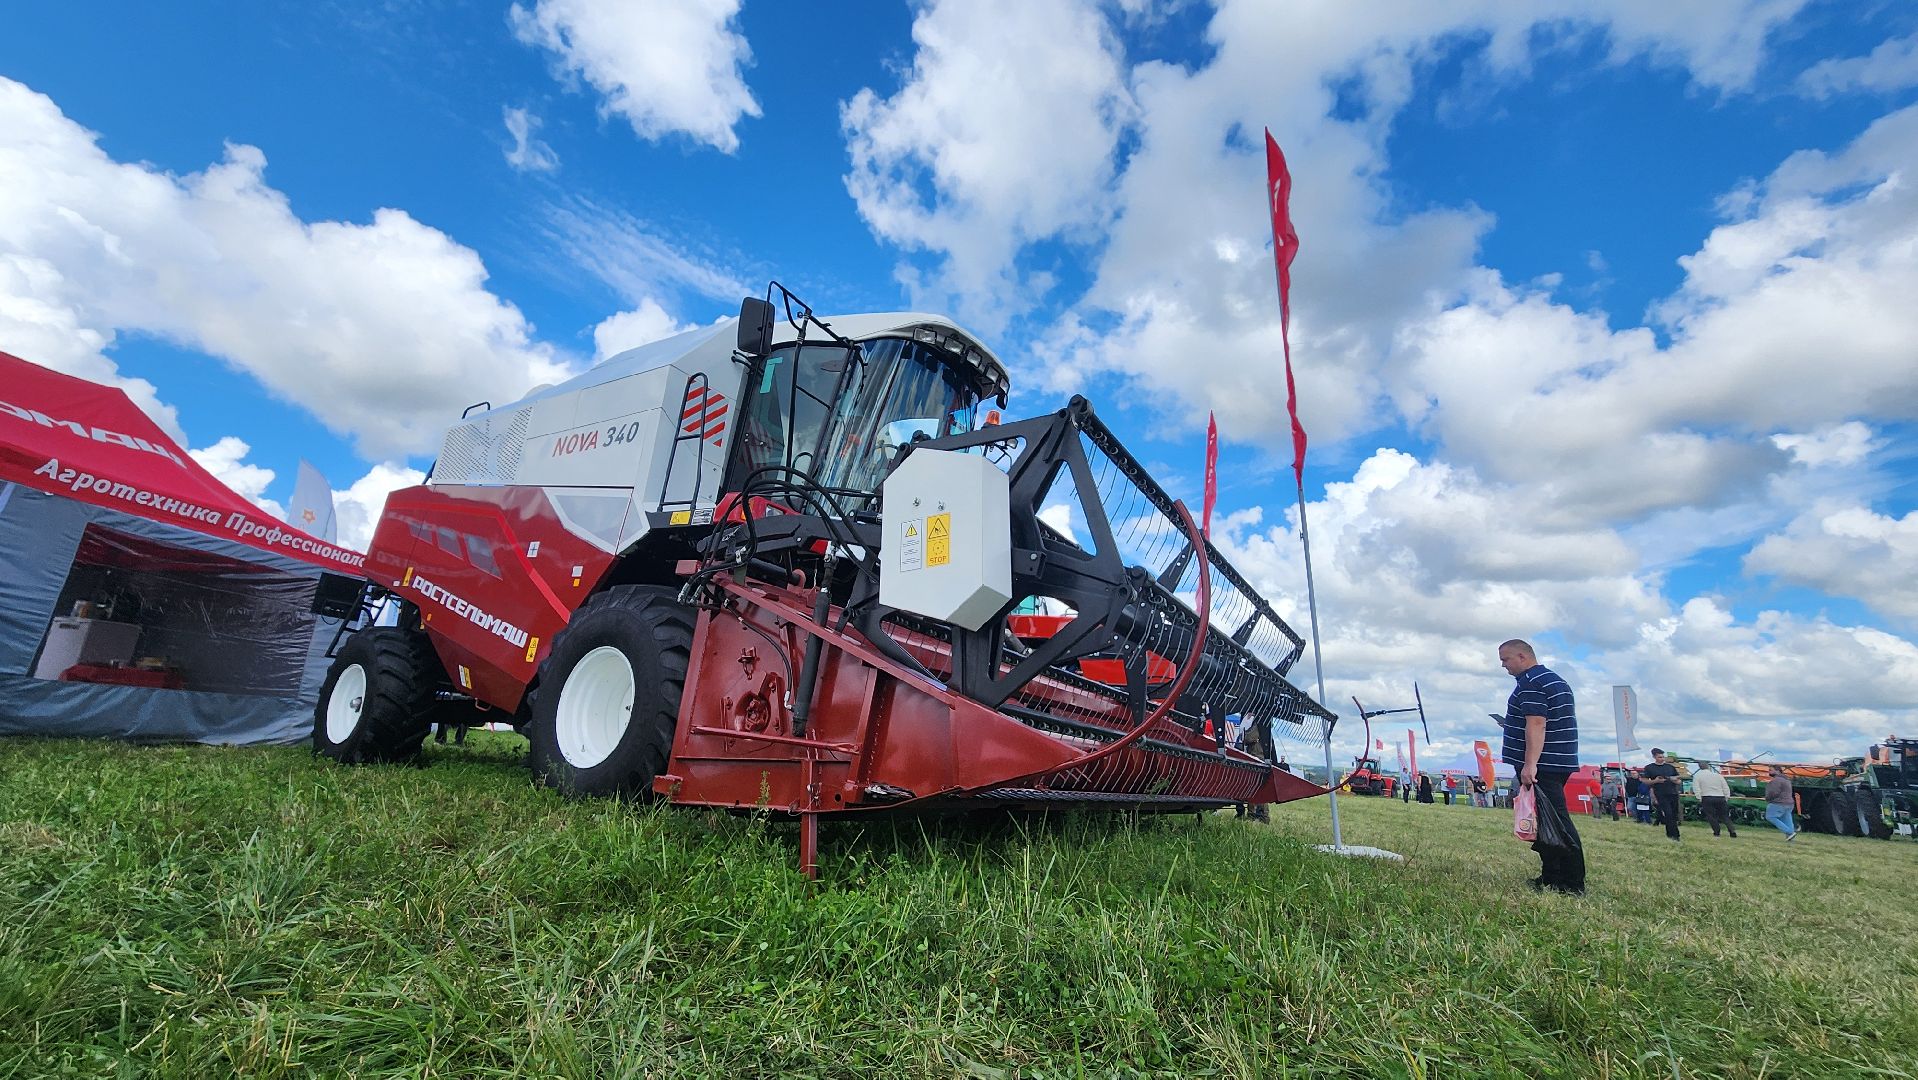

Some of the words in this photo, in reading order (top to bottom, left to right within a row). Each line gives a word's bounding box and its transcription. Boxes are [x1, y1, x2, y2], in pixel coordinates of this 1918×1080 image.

[551, 430, 599, 458] NOVA
[602, 421, 640, 447] 340
[33, 458, 222, 525] Агротехника
[929, 555, 948, 564] STOP
[411, 575, 529, 649] РОСТСЕЛЬМАШ
